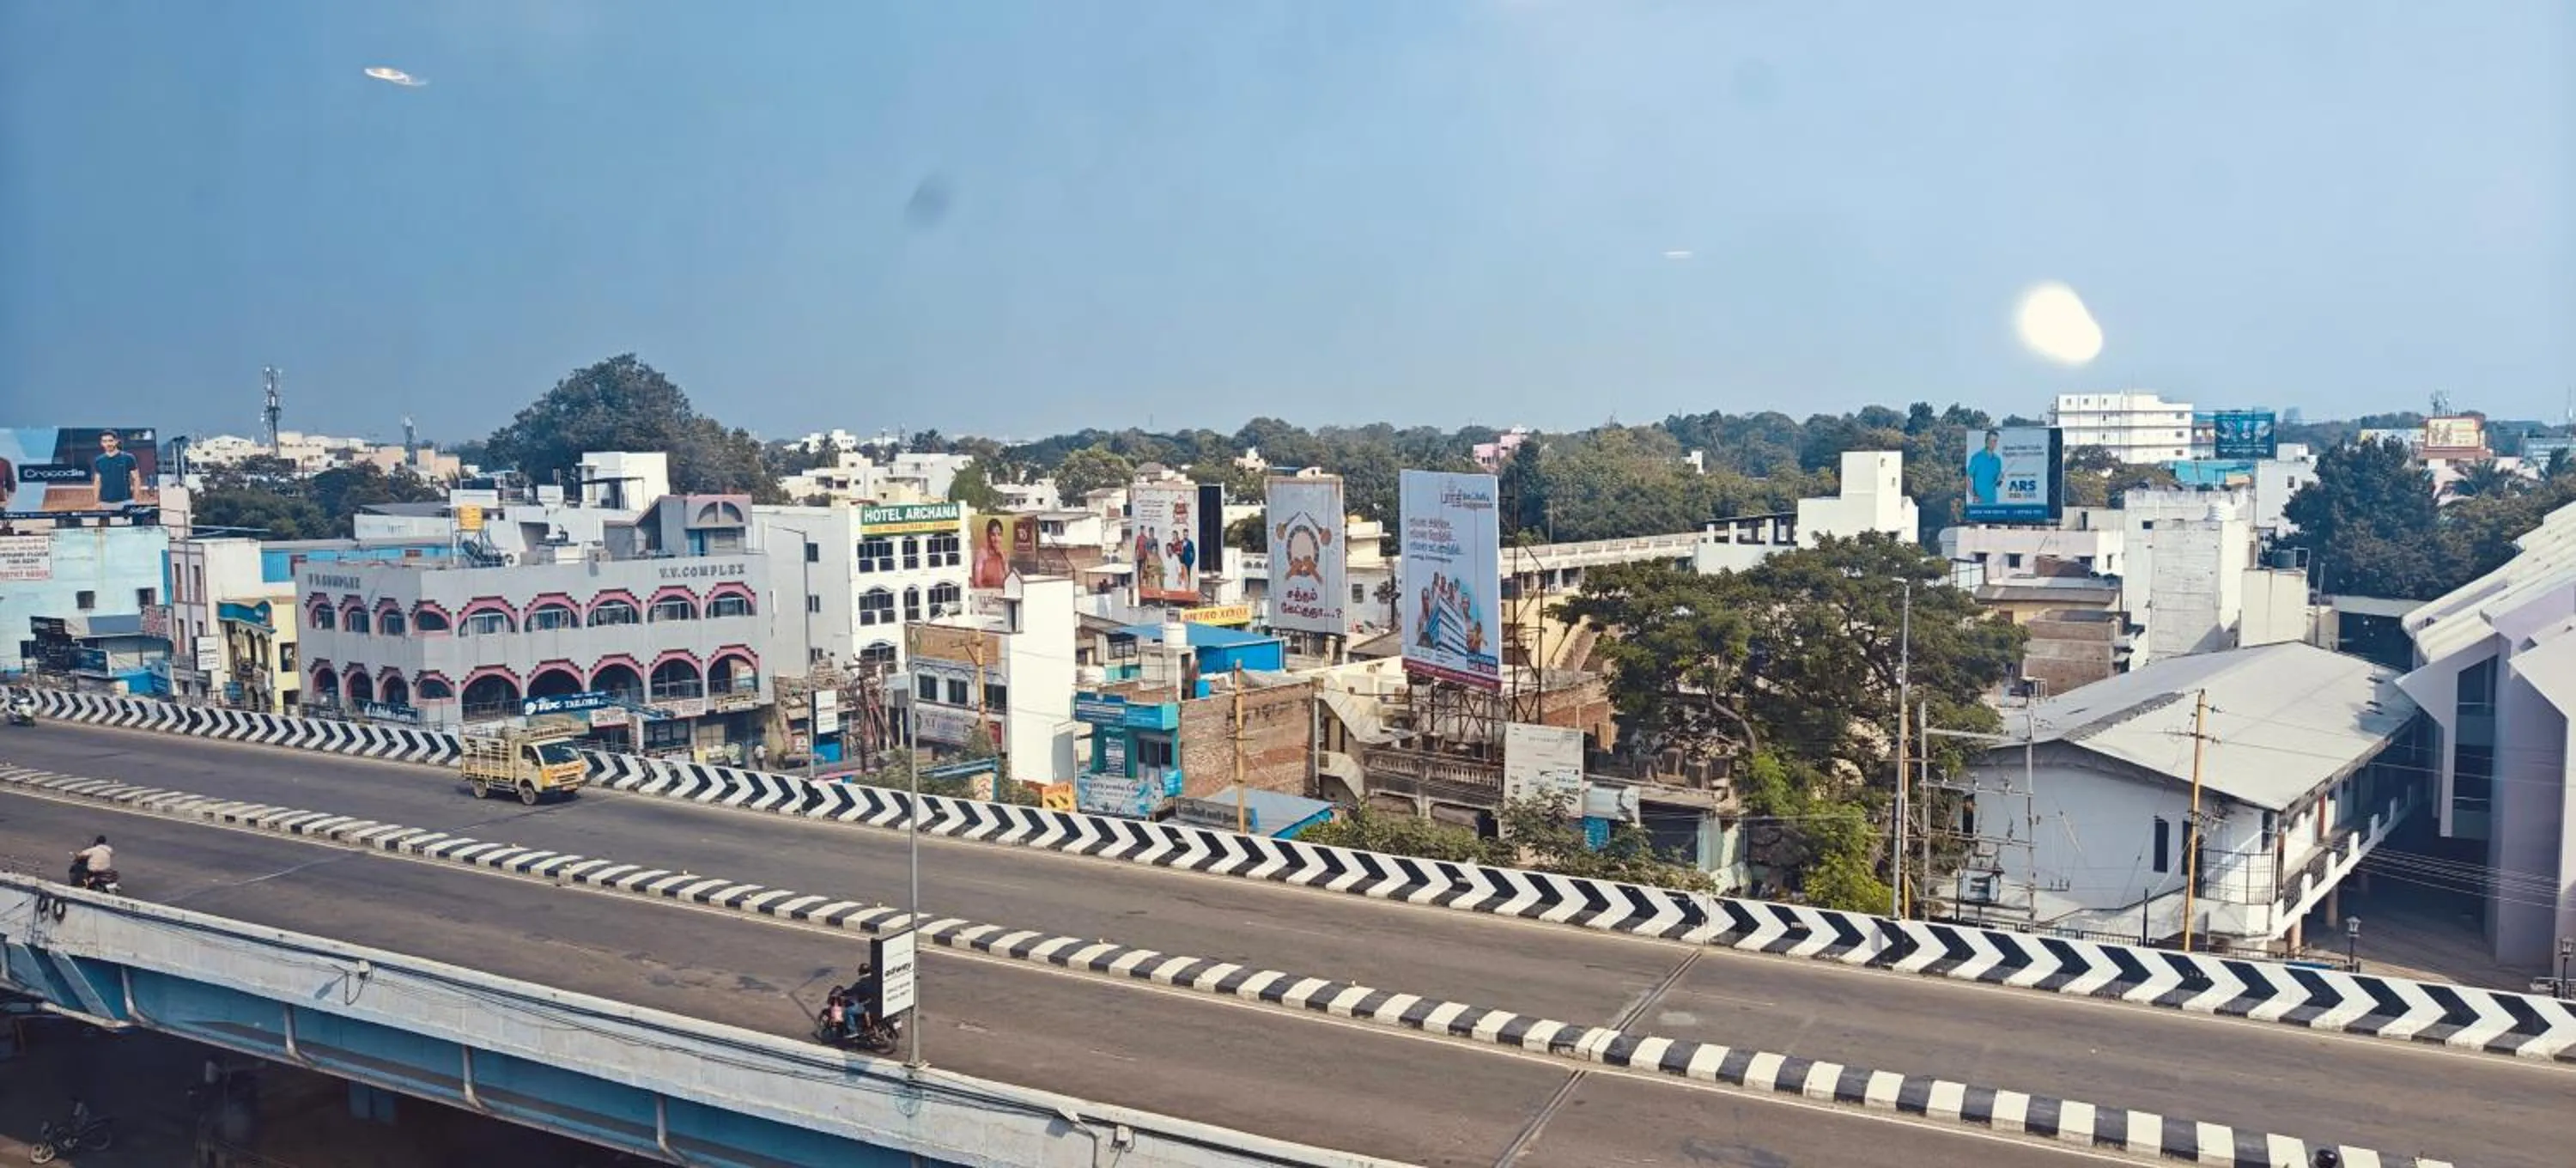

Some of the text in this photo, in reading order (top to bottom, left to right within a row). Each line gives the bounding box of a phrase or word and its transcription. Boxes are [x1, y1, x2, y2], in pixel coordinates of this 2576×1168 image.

[24, 468, 85, 478] Crocodile
[2008, 481, 2036, 491] ARS
[865, 505, 957, 522] HOTEL ARCHANA
